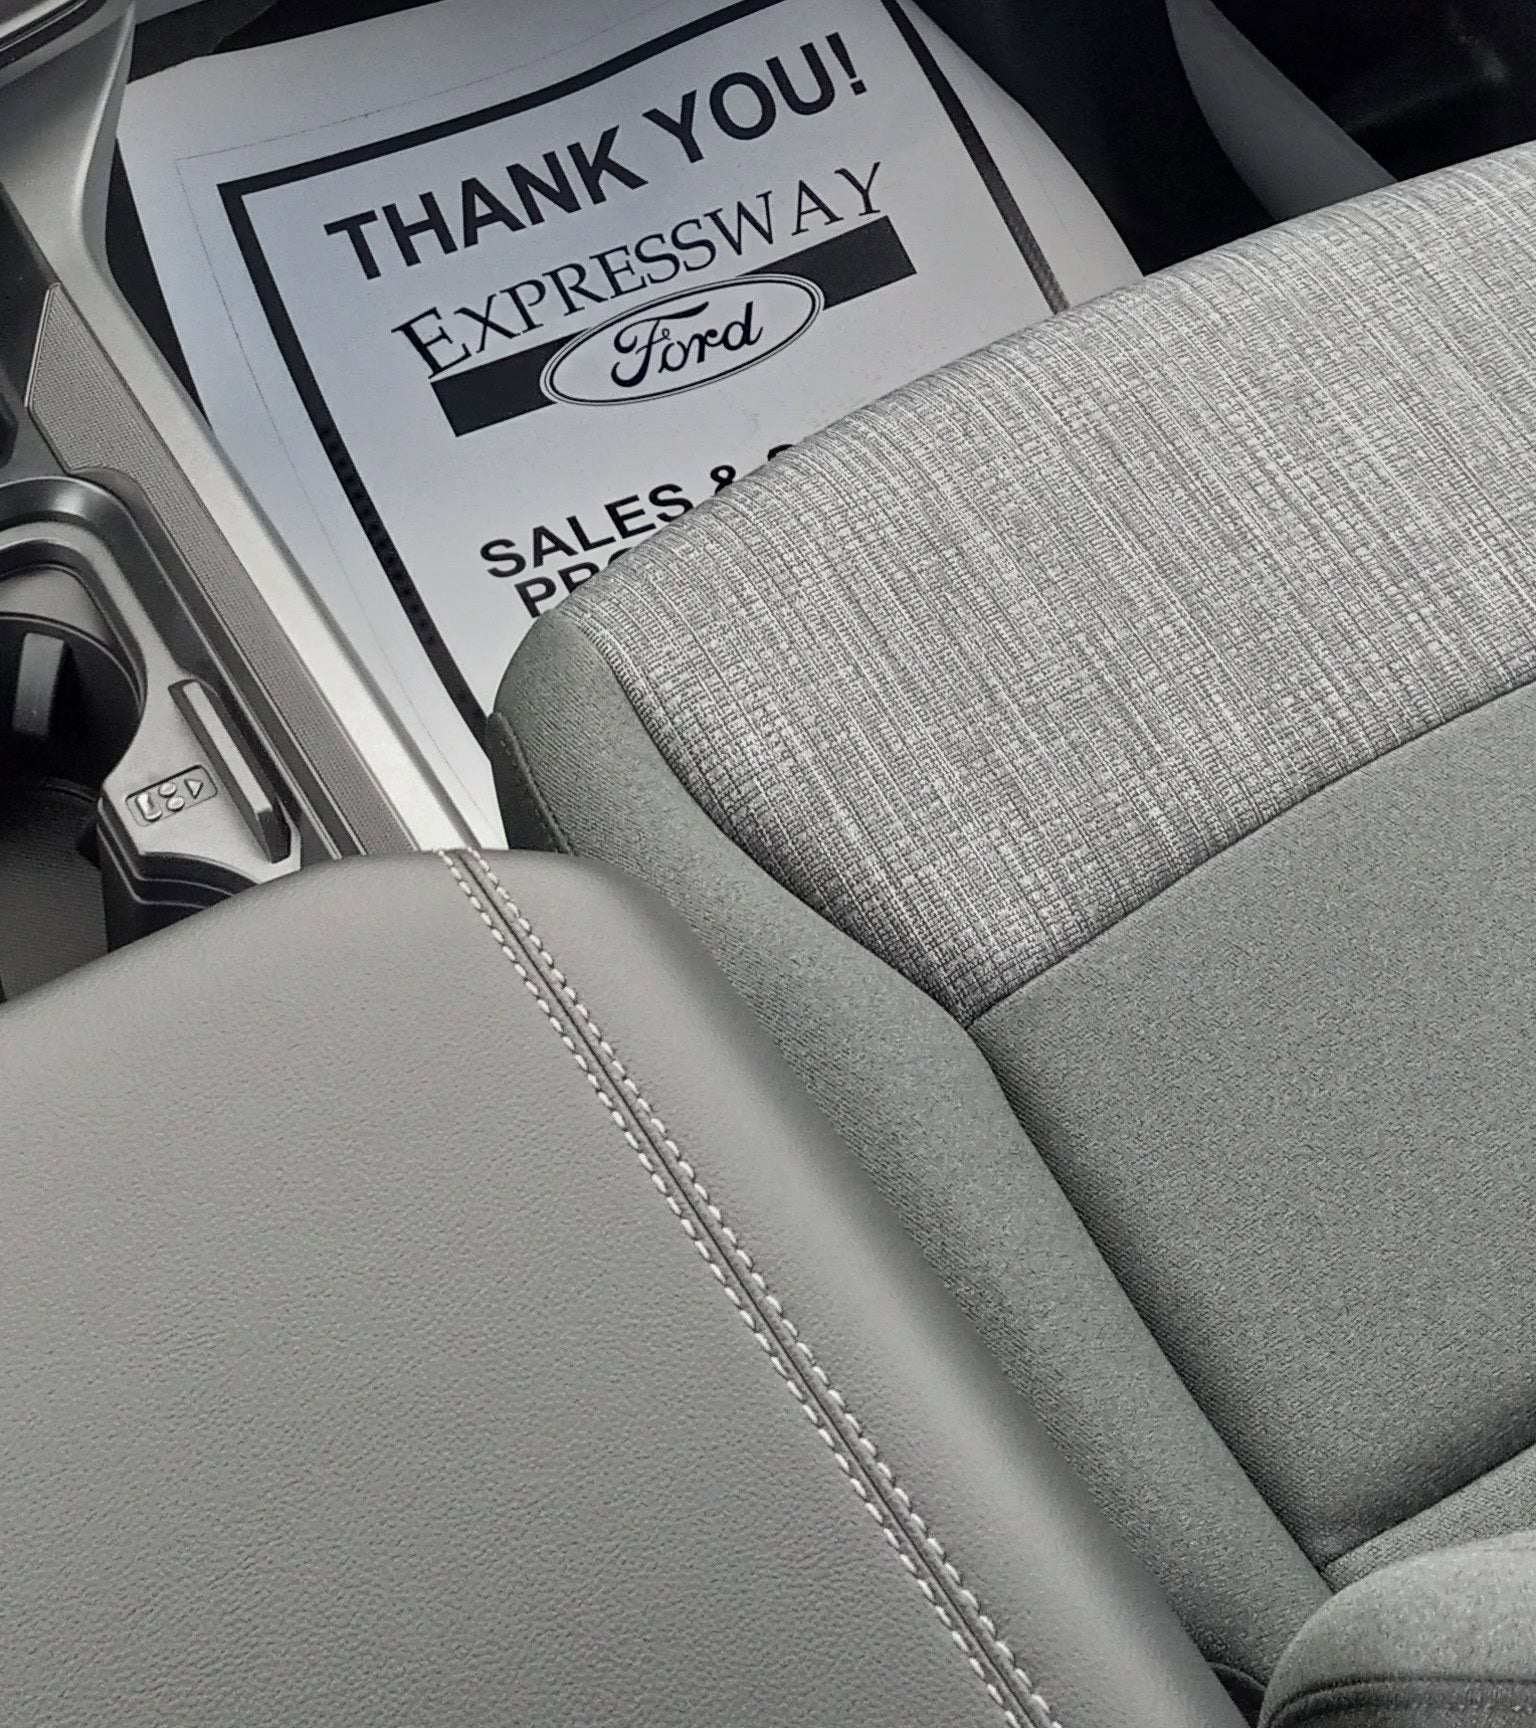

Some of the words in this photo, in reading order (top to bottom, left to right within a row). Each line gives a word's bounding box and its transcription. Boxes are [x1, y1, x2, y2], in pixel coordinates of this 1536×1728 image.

[324, 126, 649, 282] THANK
[642, 30, 870, 164] YOU!
[391, 161, 885, 380] EXPRESSWAY
[608, 297, 764, 389] Ford
[480, 482, 694, 578] SALES
